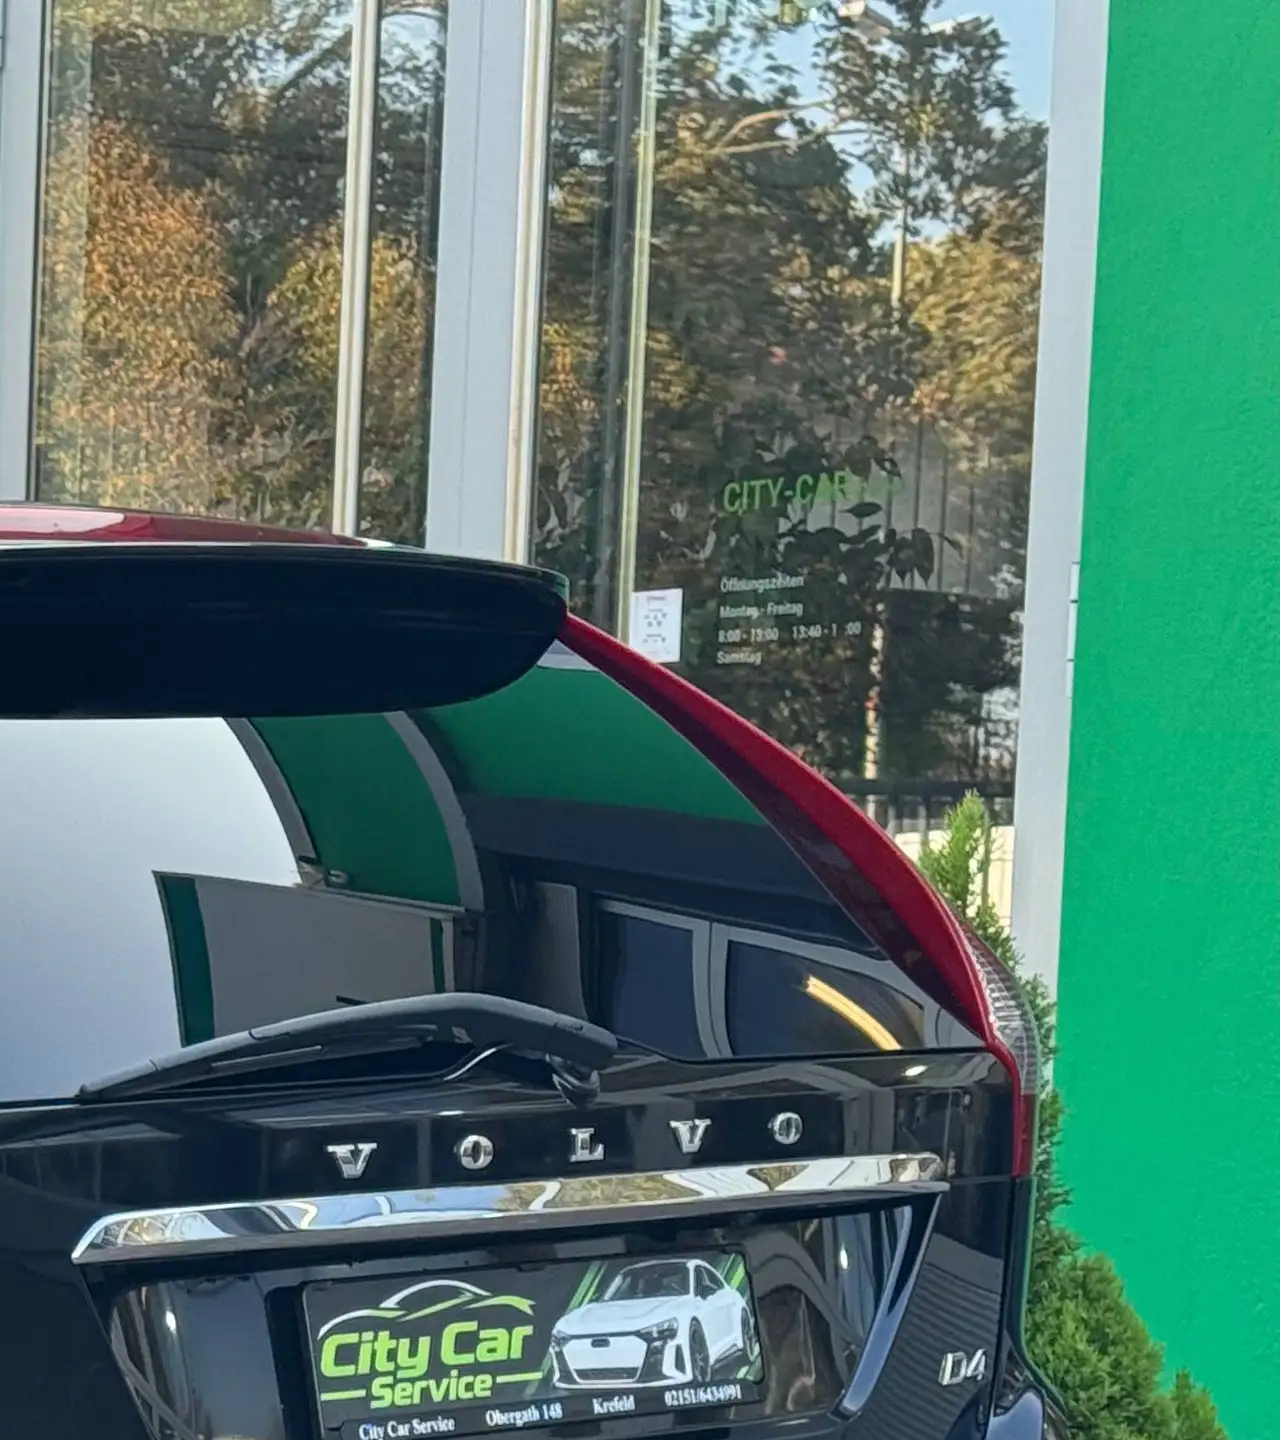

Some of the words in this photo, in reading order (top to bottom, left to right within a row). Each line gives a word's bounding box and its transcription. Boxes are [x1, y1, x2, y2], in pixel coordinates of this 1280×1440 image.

[766, 603, 804, 618] Freitag
[716, 650, 762, 666] Samstag
[326, 1111, 804, 1180] VOLVO
[319, 1330, 431, 1379] City
[441, 1320, 534, 1366] Car
[938, 1347, 987, 1387] D4
[370, 1369, 495, 1410] Service
[387, 1419, 411, 1439] Car
[412, 1415, 455, 1436] Service
[485, 1404, 540, 1427] Obergath
[542, 1402, 563, 1420] 148
[592, 1394, 636, 1415] Krefeld
